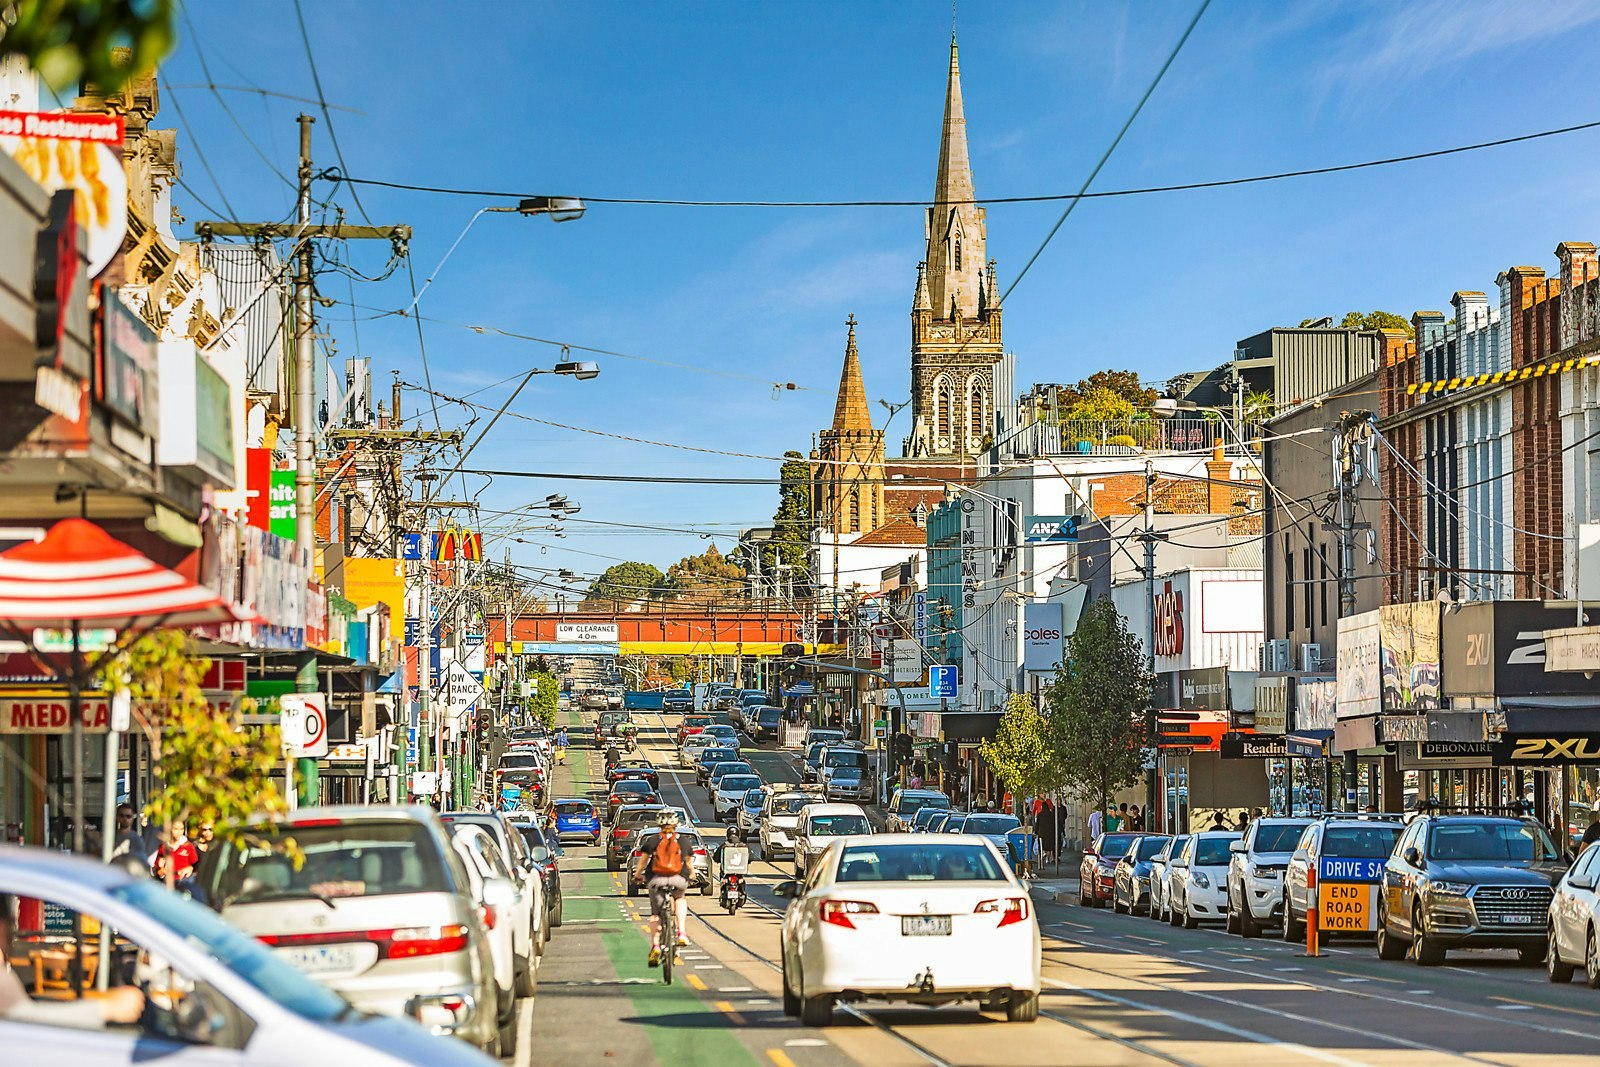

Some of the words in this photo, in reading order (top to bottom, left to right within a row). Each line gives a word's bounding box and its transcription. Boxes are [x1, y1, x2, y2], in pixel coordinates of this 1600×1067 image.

[1029, 522, 1060, 535] ANZ
[961, 498, 977, 608] CINEMAS
[1024, 627, 1060, 640] coles
[1466, 633, 1491, 666] 2XU
[939, 668, 949, 680] P
[1426, 743, 1493, 753] DEBONAIRE
[1511, 738, 1600, 759] 2XU
[1326, 861, 1362, 877] DRIVE
[1331, 887, 1358, 899] END
[1326, 901, 1363, 914] ROAD
[1326, 916, 1362, 928] WORK
